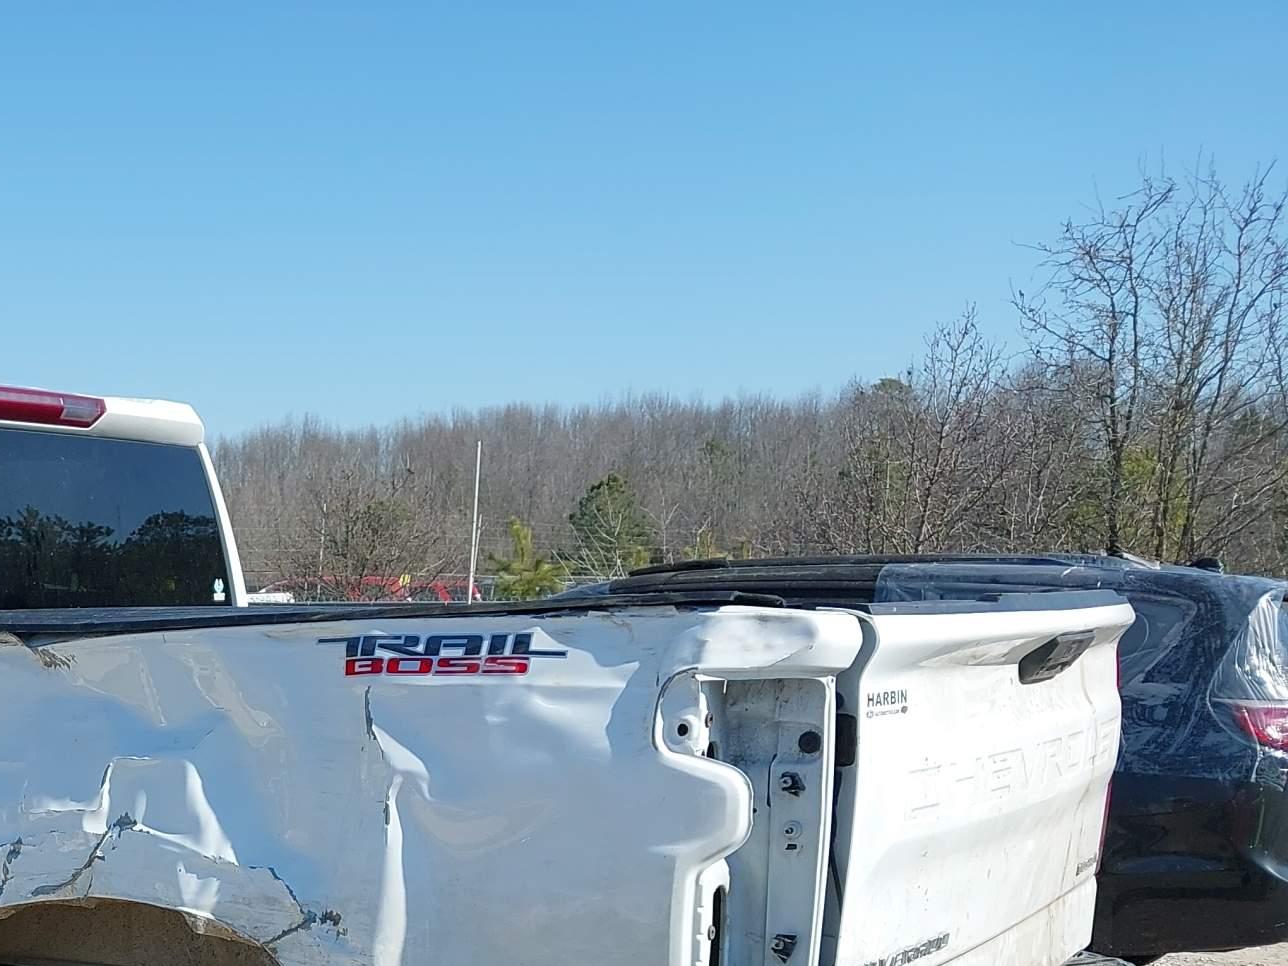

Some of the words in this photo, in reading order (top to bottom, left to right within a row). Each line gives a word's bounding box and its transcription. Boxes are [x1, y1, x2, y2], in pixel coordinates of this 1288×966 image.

[317, 631, 569, 659] TRAIL
[344, 655, 531, 677] BOSS
[866, 688, 908, 708] HARBIN
